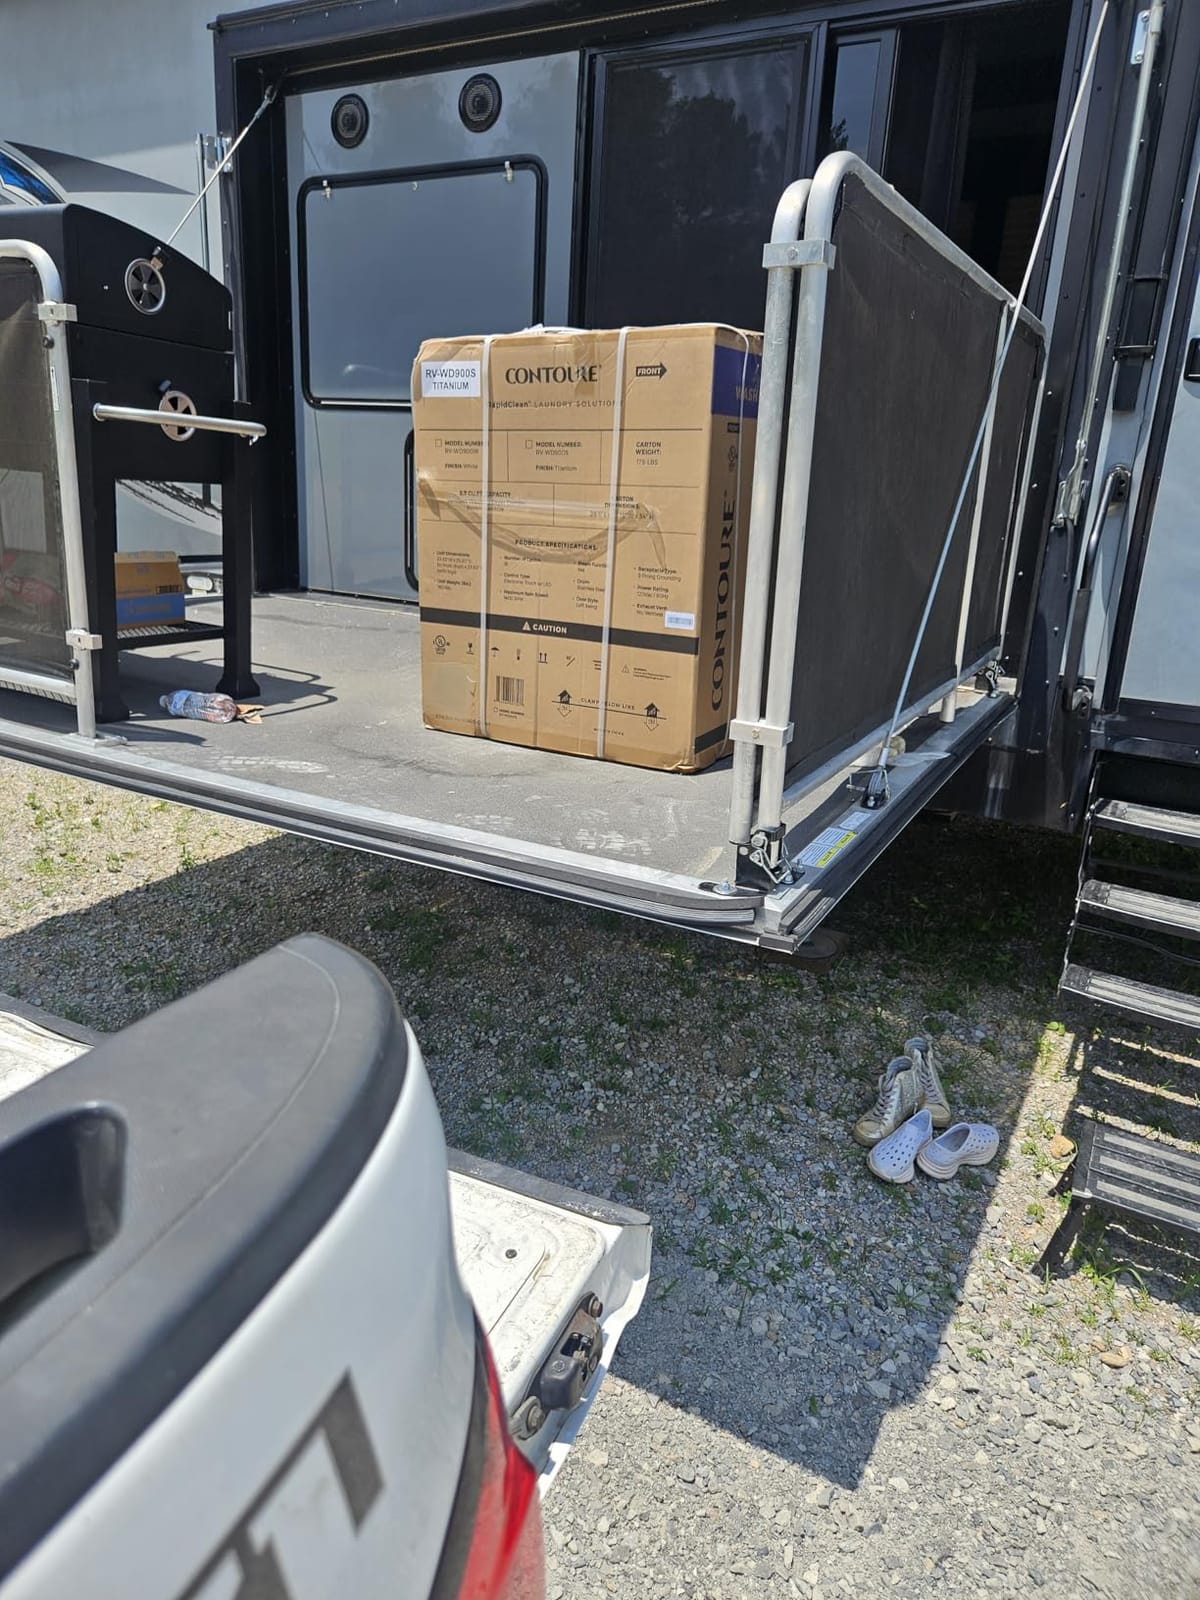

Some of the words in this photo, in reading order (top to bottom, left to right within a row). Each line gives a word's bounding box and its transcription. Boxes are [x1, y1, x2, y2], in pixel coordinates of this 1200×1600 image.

[425, 368, 477, 379] RV-WD900S
[504, 364, 600, 385] CONTOURE
[637, 366, 661, 376] FRONT
[432, 381, 470, 391] TITANIUM
[534, 401, 573, 409] LAUNDRY
[514, 539, 544, 547] PRODUCT
[711, 499, 736, 712] CONTOURE
[532, 623, 568, 634] CAUTION
